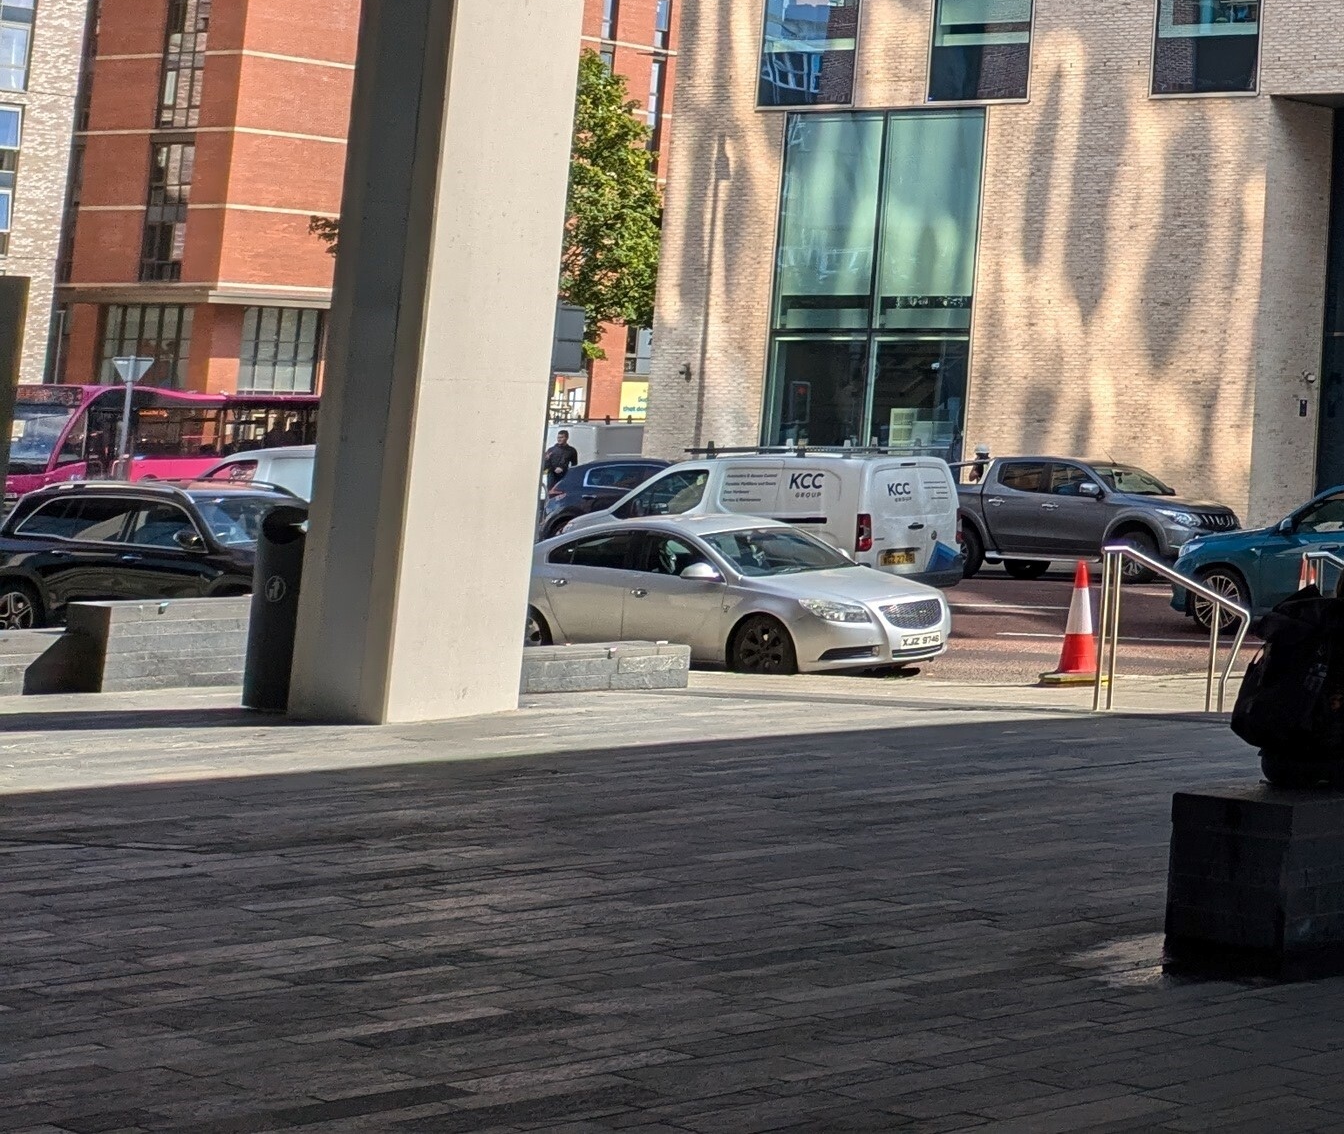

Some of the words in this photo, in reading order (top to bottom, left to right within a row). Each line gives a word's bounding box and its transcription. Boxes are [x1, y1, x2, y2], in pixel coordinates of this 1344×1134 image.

[789, 473, 824, 489] KCC
[887, 482, 911, 496] KCC
[903, 638, 920, 646] XJZ
